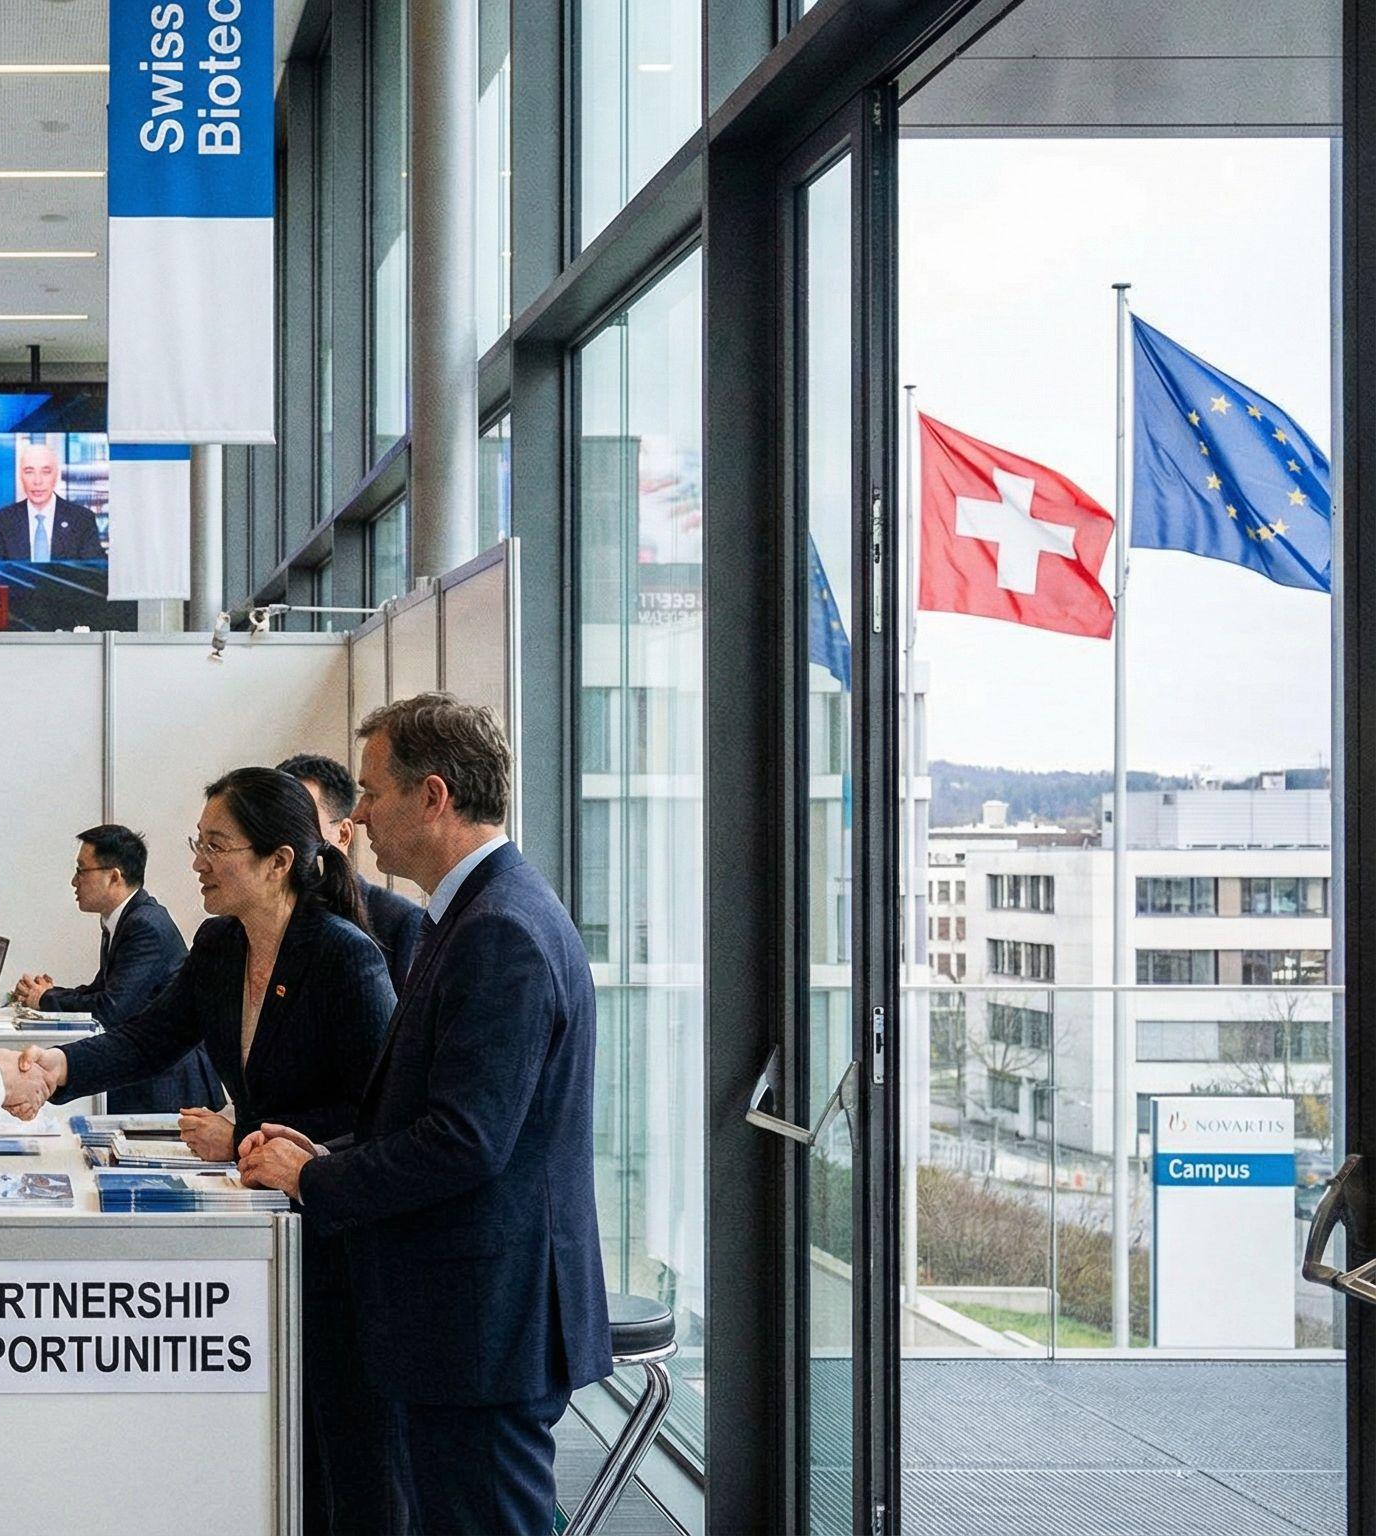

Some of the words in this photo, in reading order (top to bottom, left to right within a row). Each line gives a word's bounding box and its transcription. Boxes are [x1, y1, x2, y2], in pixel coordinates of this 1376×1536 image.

[139, 3, 185, 154] Swiss
[1195, 1119, 1285, 1134] NOVARTIS
[1168, 1158, 1251, 1184] Campus
